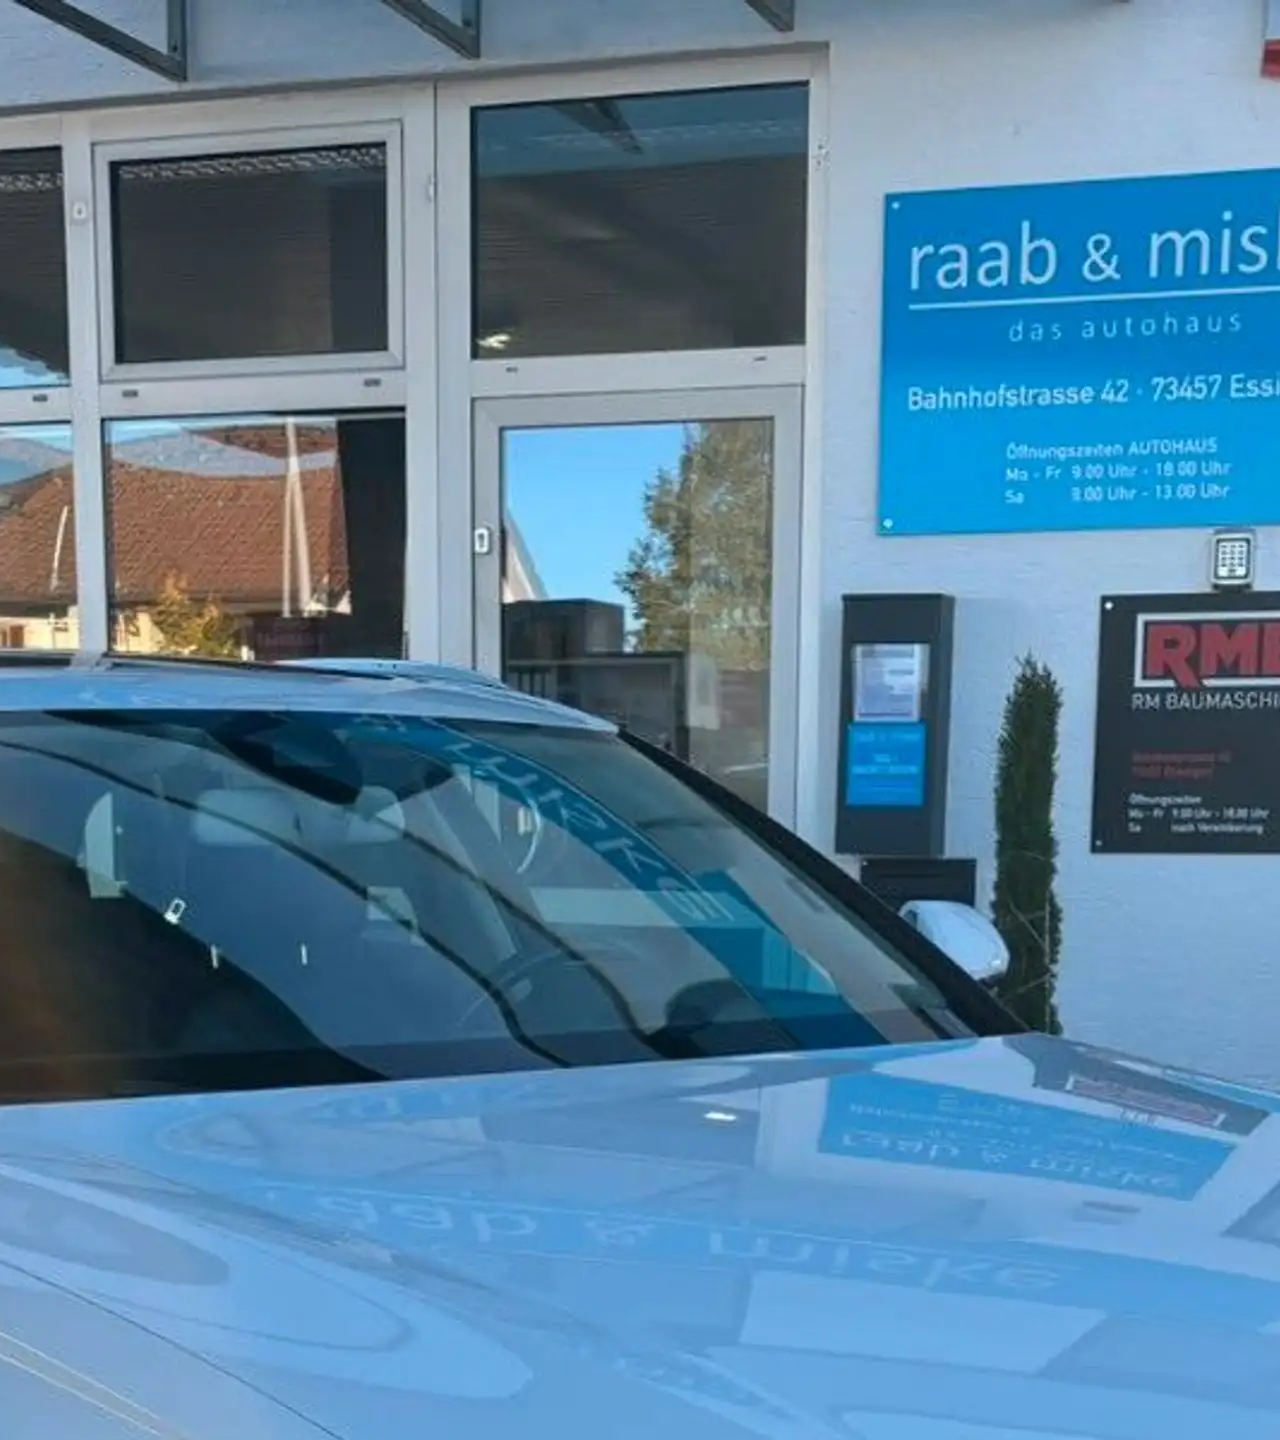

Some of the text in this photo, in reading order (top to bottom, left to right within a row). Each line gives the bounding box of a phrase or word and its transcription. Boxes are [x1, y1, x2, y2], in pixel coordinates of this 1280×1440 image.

[910, 220, 1057, 290] raab
[1082, 233, 1120, 282] &
[1009, 312, 1242, 342] das autohaus
[908, 383, 1094, 411] Bahnhofstrasse
[1100, 378, 1129, 404] 42
[1150, 374, 1222, 402] 73457
[1128, 436, 1217, 456] AUTOHAUS
[1131, 692, 1160, 711] RM
